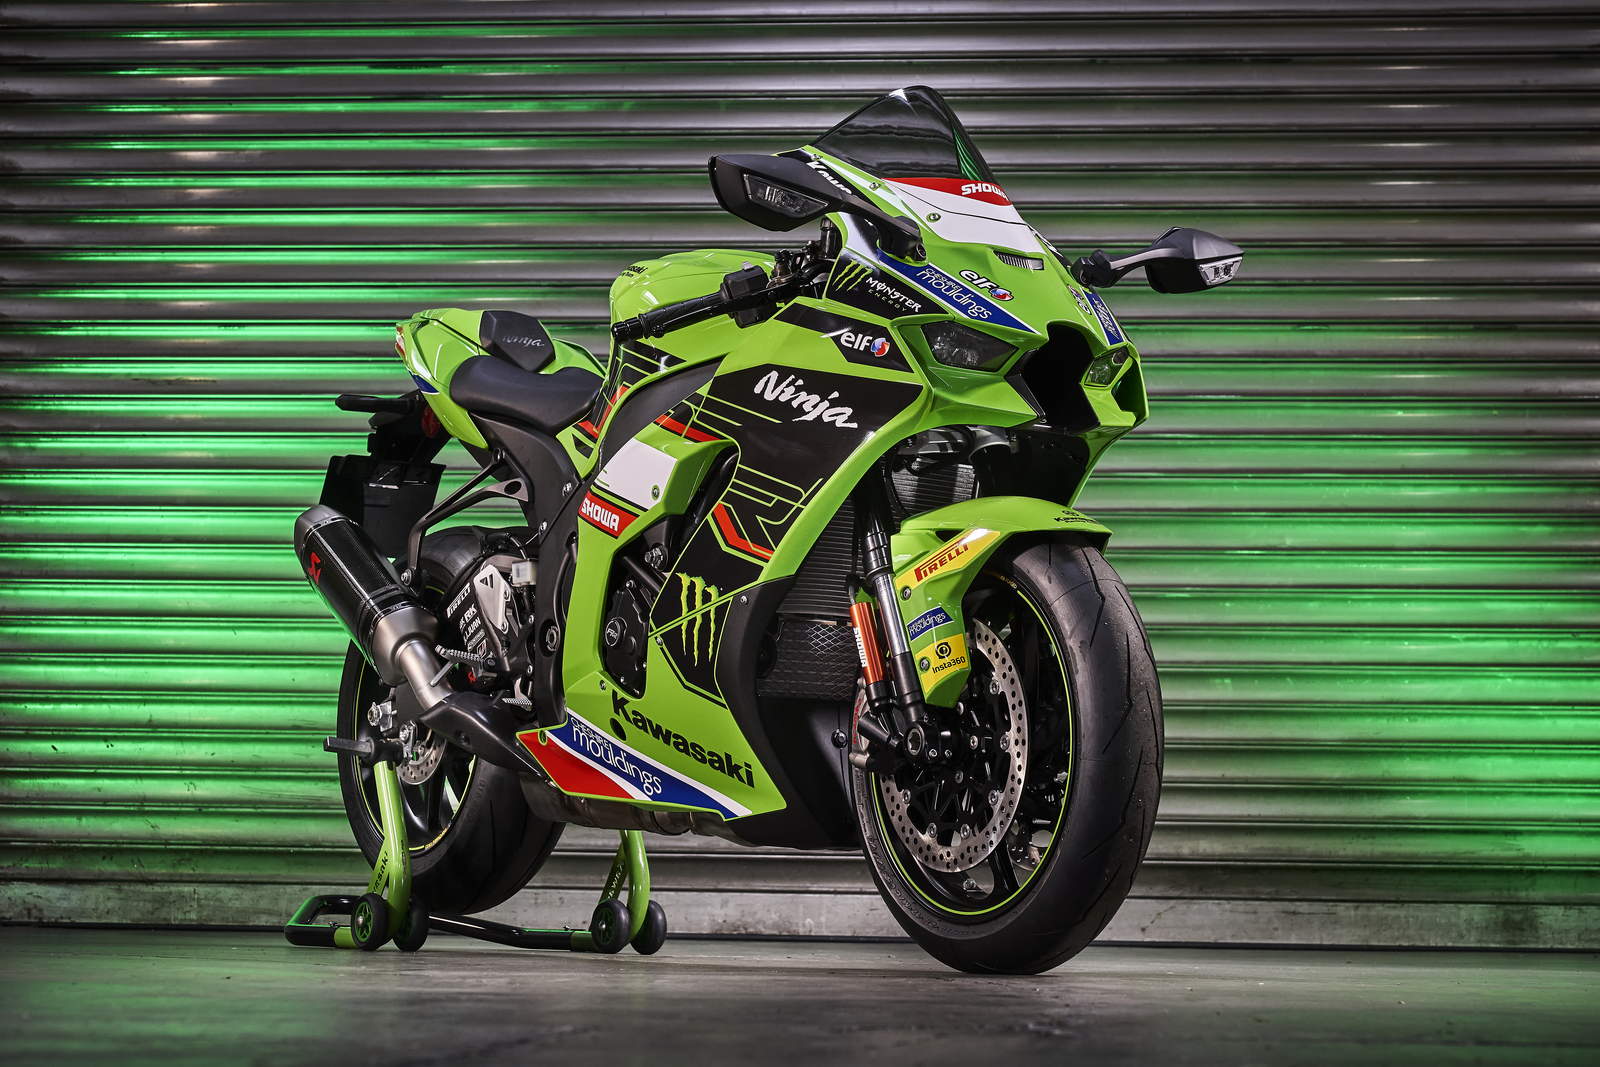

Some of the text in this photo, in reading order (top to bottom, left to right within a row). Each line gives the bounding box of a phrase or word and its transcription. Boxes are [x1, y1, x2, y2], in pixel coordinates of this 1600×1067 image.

[916, 270, 992, 319] mouldings
[840, 331, 873, 351] elf
[753, 370, 858, 428] Ninja
[581, 497, 620, 532] SHOWA
[914, 538, 969, 582] PIRELLI
[853, 627, 868, 668] SHOWA
[572, 726, 662, 796] mouldings
[612, 689, 755, 788] Kawasaki
